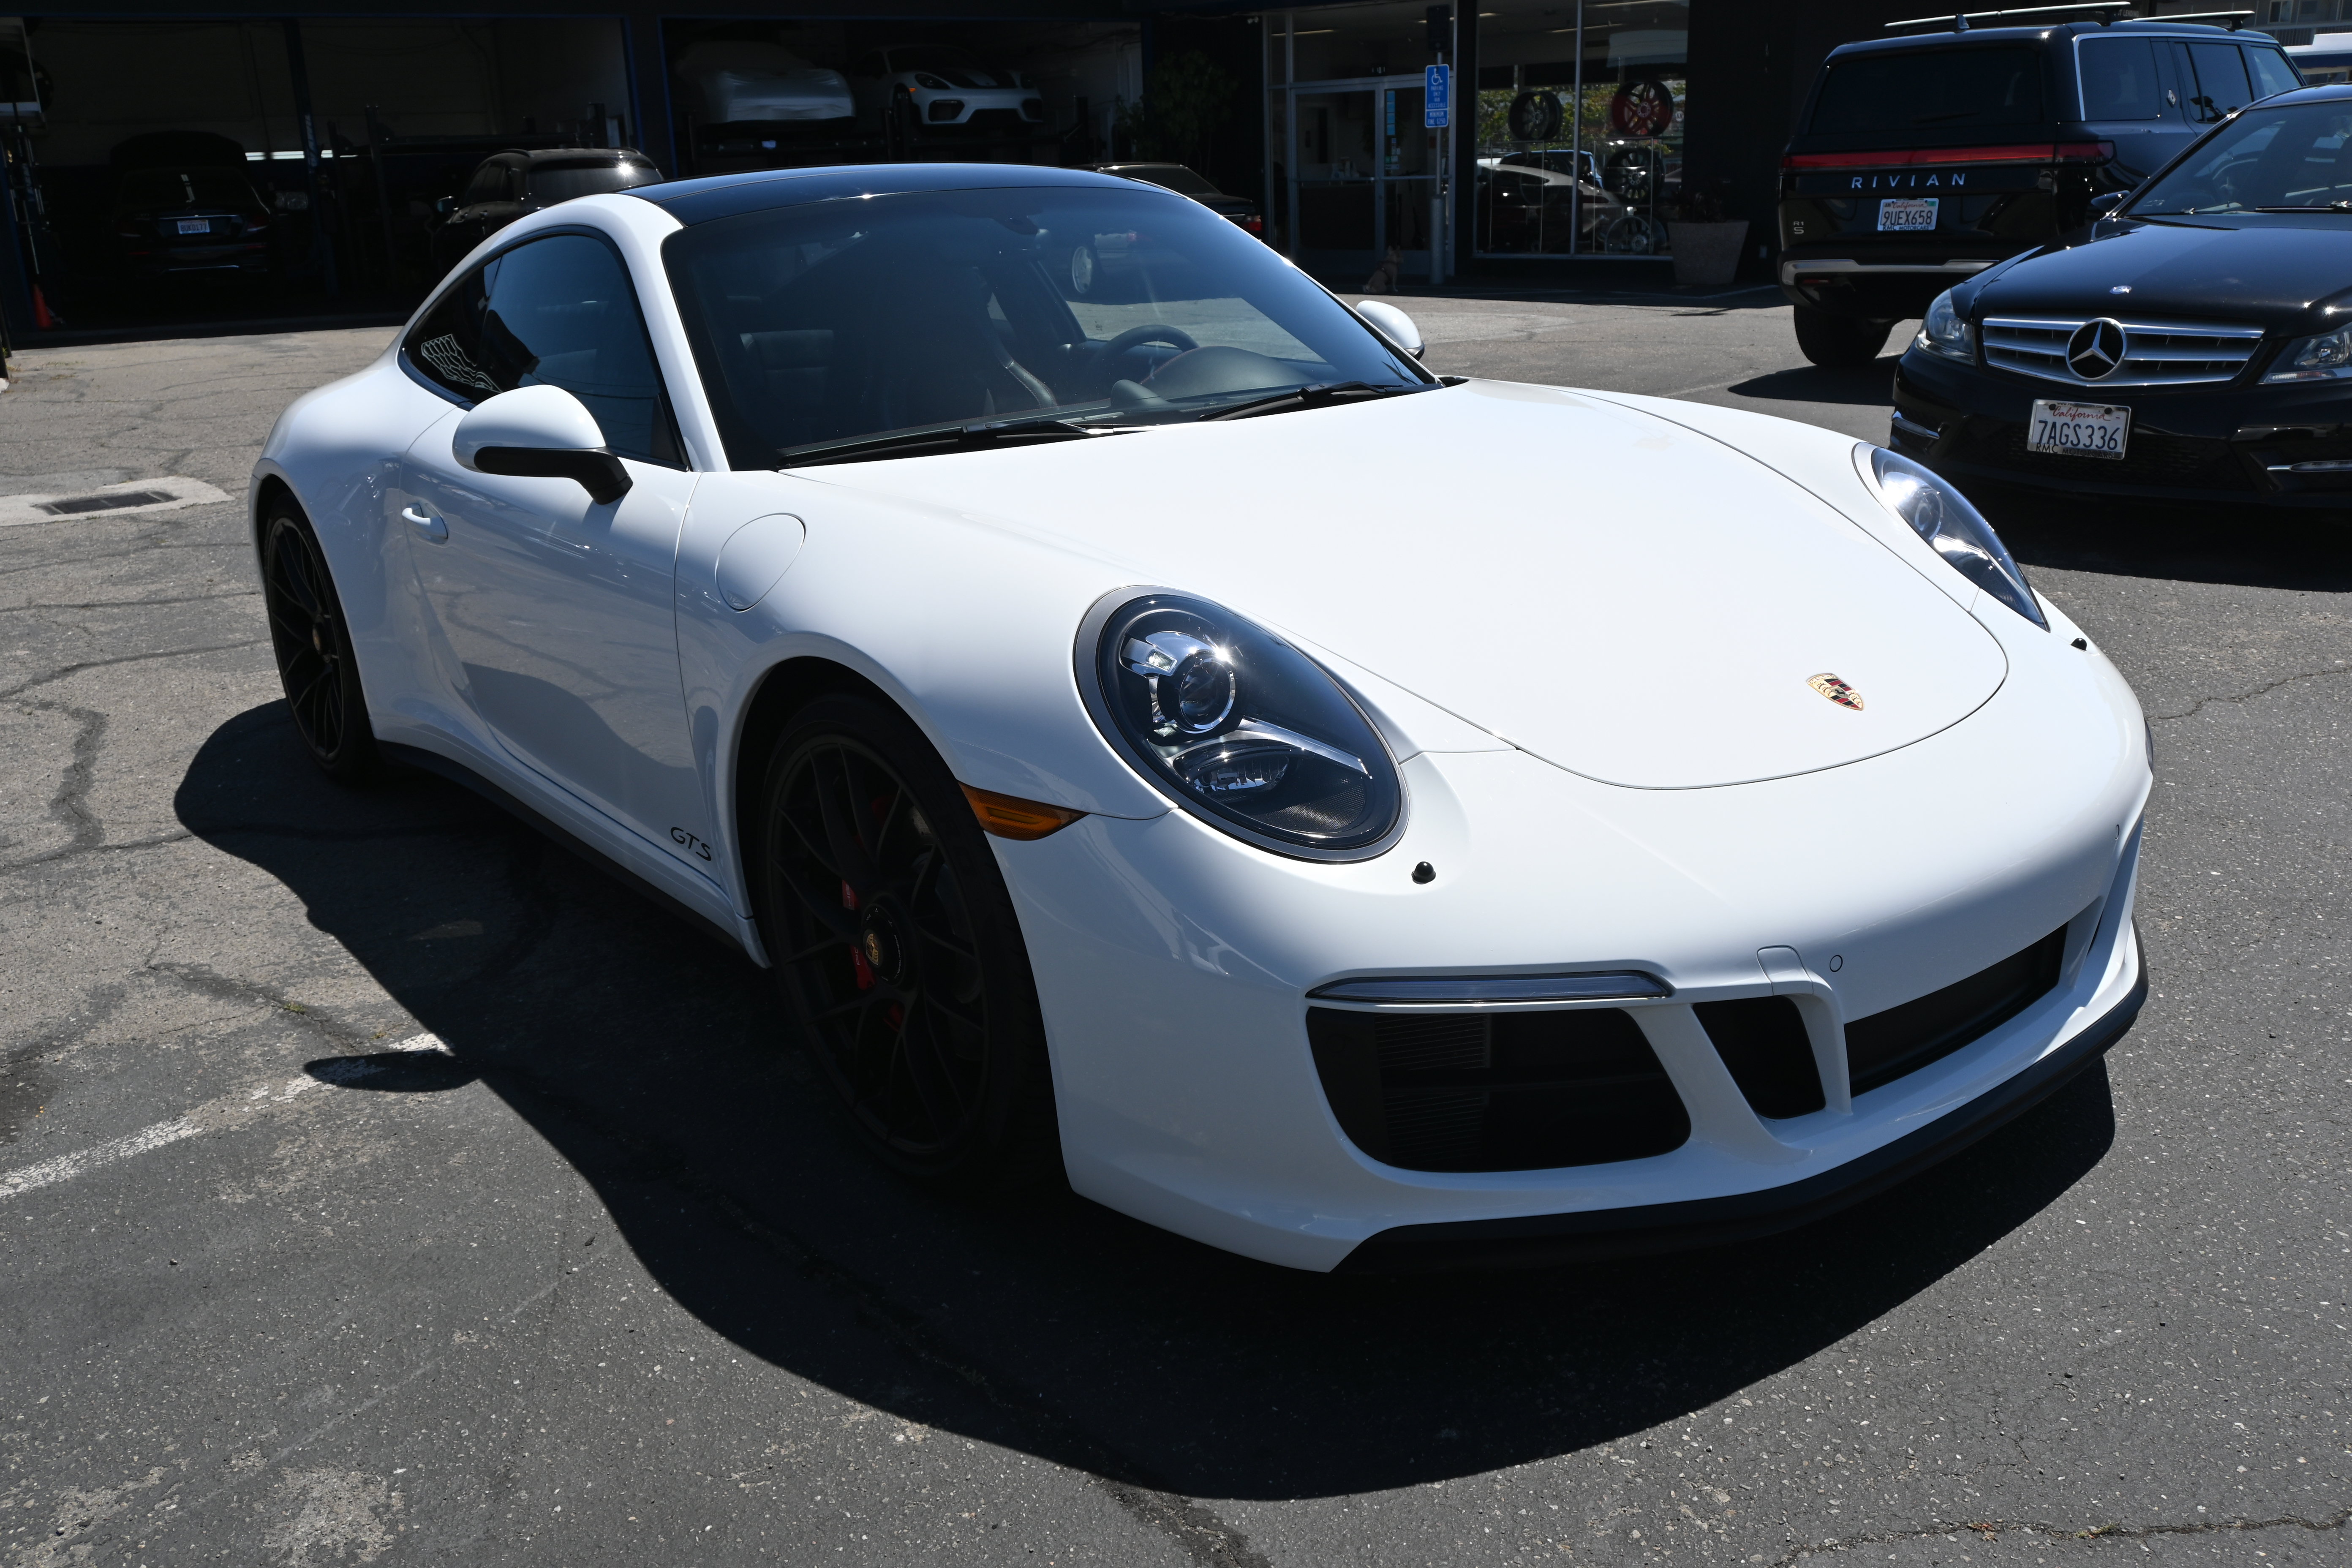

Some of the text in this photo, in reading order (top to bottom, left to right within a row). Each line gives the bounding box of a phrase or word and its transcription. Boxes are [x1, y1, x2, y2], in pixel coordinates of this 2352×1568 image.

[1851, 173, 1966, 189] RIVIAN
[1893, 201, 1927, 210] California
[1883, 210, 1933, 225] 9UEX658
[2053, 406, 2111, 422] California
[2039, 420, 2121, 450] 7AGS336
[2036, 443, 2114, 459] RMC MOTORCARS
[670, 827, 712, 861] GTS
